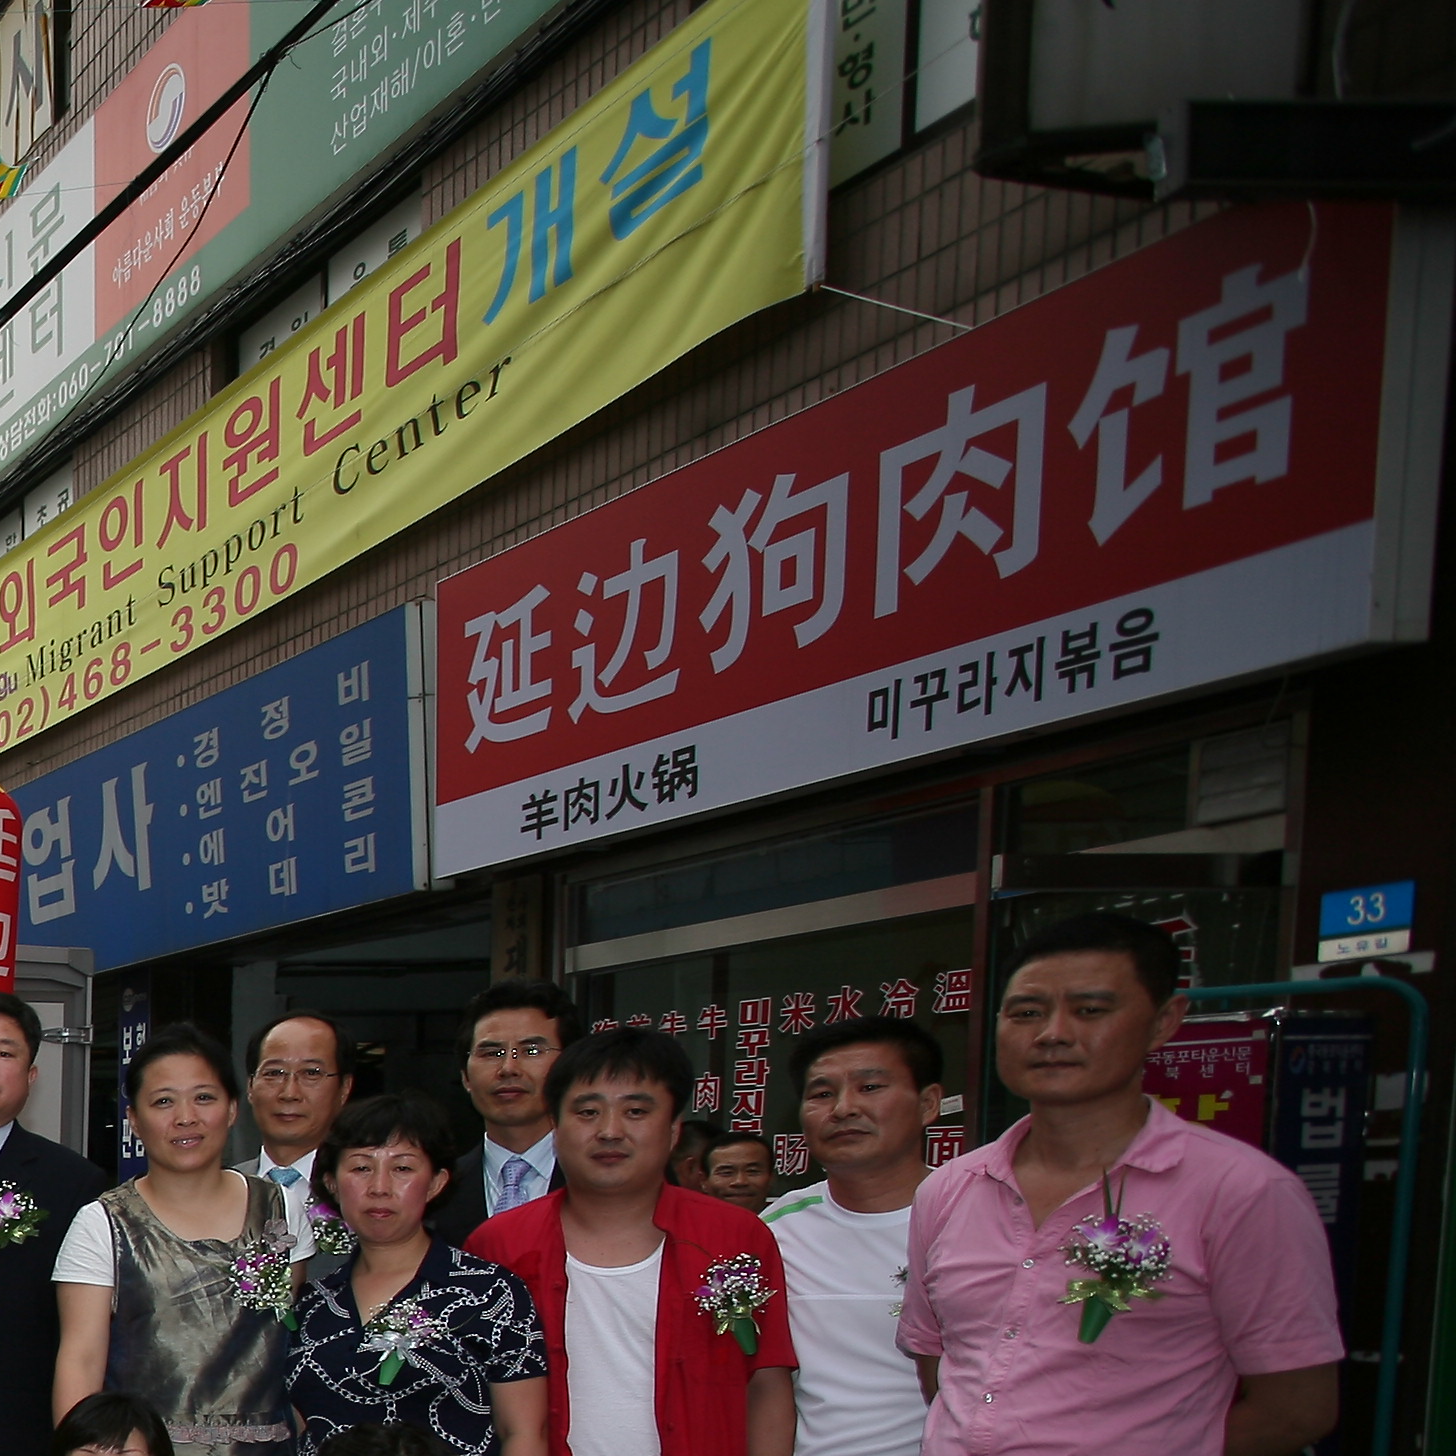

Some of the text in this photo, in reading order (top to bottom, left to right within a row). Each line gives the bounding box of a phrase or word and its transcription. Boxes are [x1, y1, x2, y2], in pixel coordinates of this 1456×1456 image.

[482, 36, 713, 326] 개설
[25, 594, 138, 681] Migrant
[157, 499, 305, 608] Support
[332, 353, 512, 497] Center
[462, 262, 1309, 755] 延边狗肉馆
[193, 659, 371, 769] 경정비
[865, 606, 1162, 742] 미꾸라지볶음
[196, 717, 373, 820] 엔진오일
[199, 775, 377, 866] 에어콘
[521, 743, 700, 842] 羊肉火锅
[202, 832, 377, 919] 밧데리
[1346, 889, 1389, 926] 33
